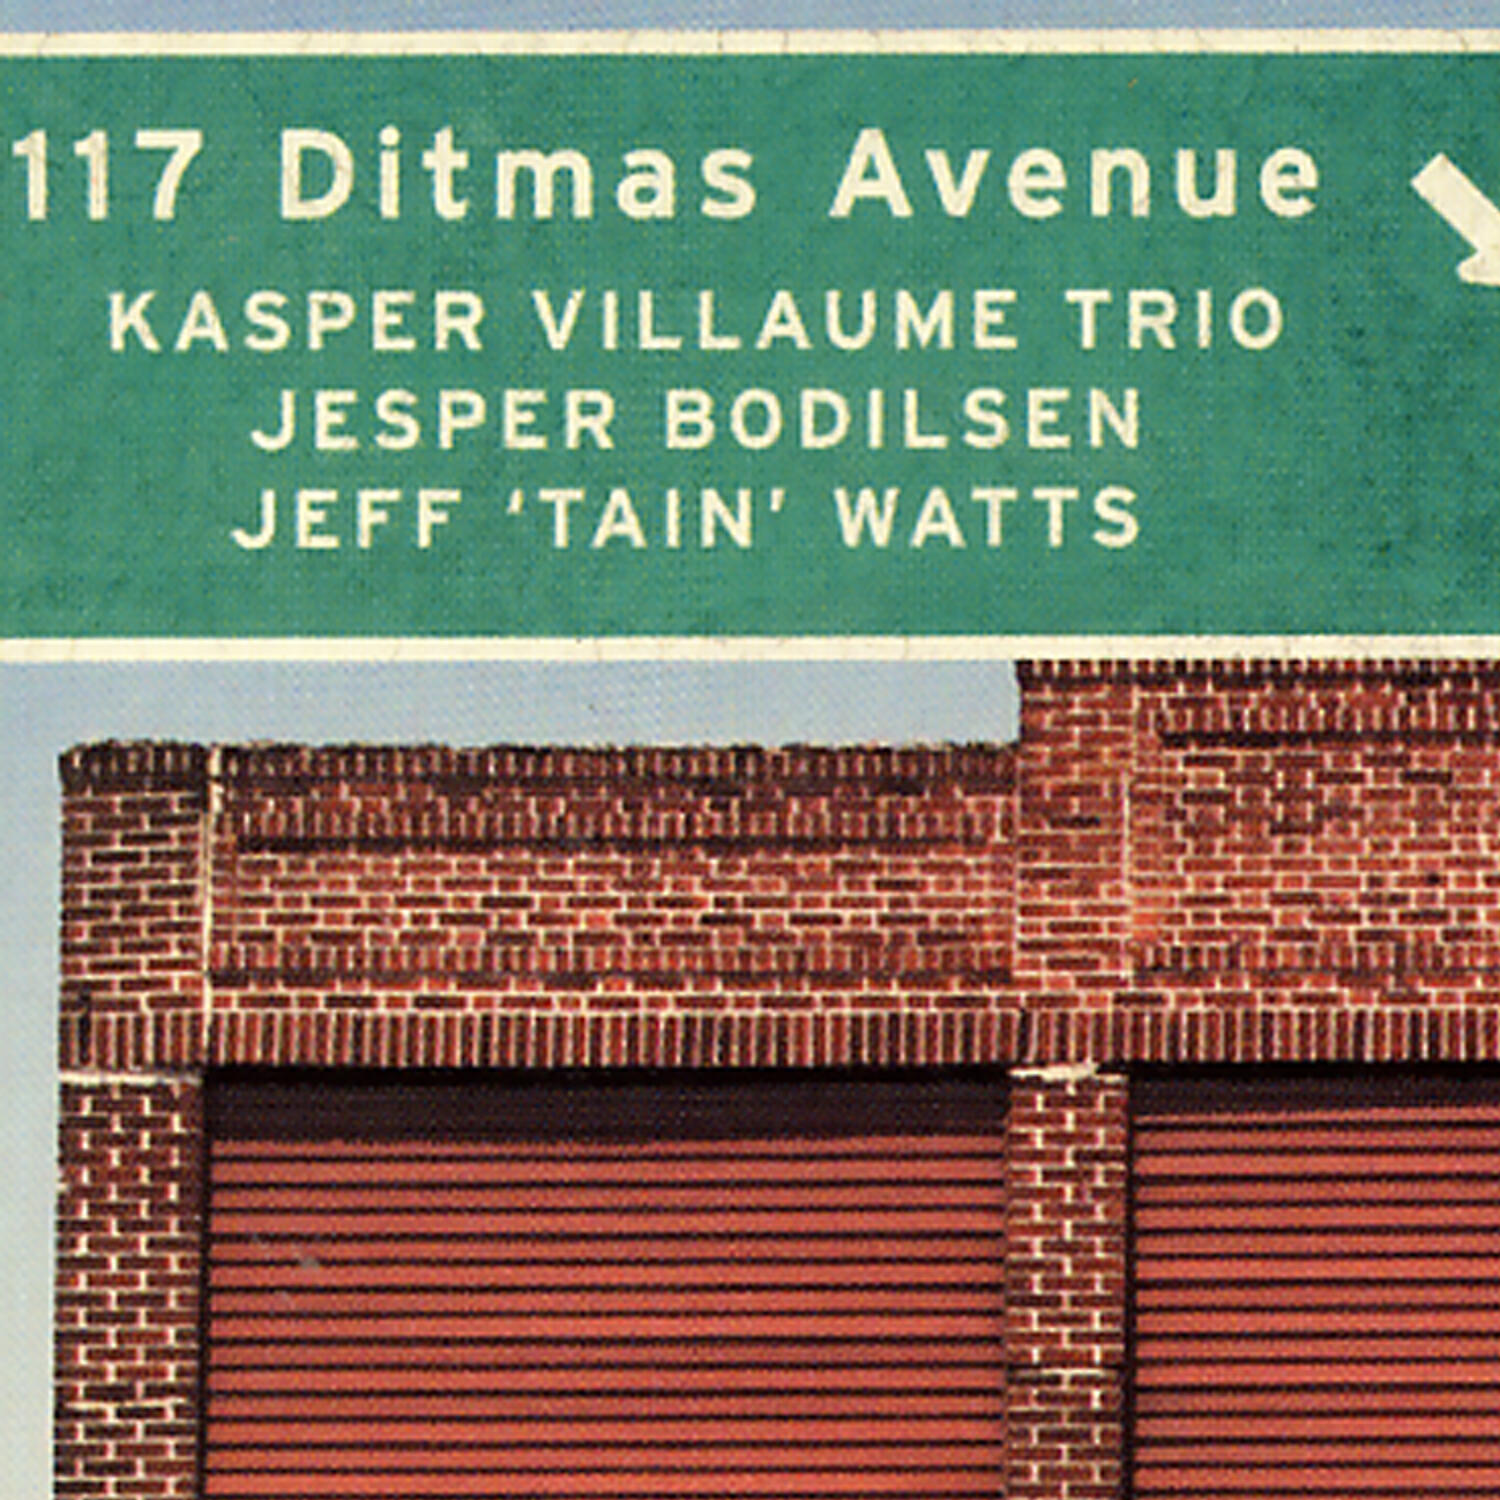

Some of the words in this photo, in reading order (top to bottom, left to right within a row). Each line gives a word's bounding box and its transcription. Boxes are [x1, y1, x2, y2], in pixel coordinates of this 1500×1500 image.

[11, 128, 204, 221] 117
[280, 125, 757, 221] Ditmas
[828, 128, 1320, 219] Avenue
[108, 289, 486, 353] KASPER
[531, 289, 1019, 352] VILLAUME
[1063, 287, 1284, 351] TRIO
[249, 388, 616, 452] JESPER
[665, 387, 1140, 451] BODILSEN
[230, 487, 463, 551] JEFF
[833, 485, 1140, 549] WATTS
